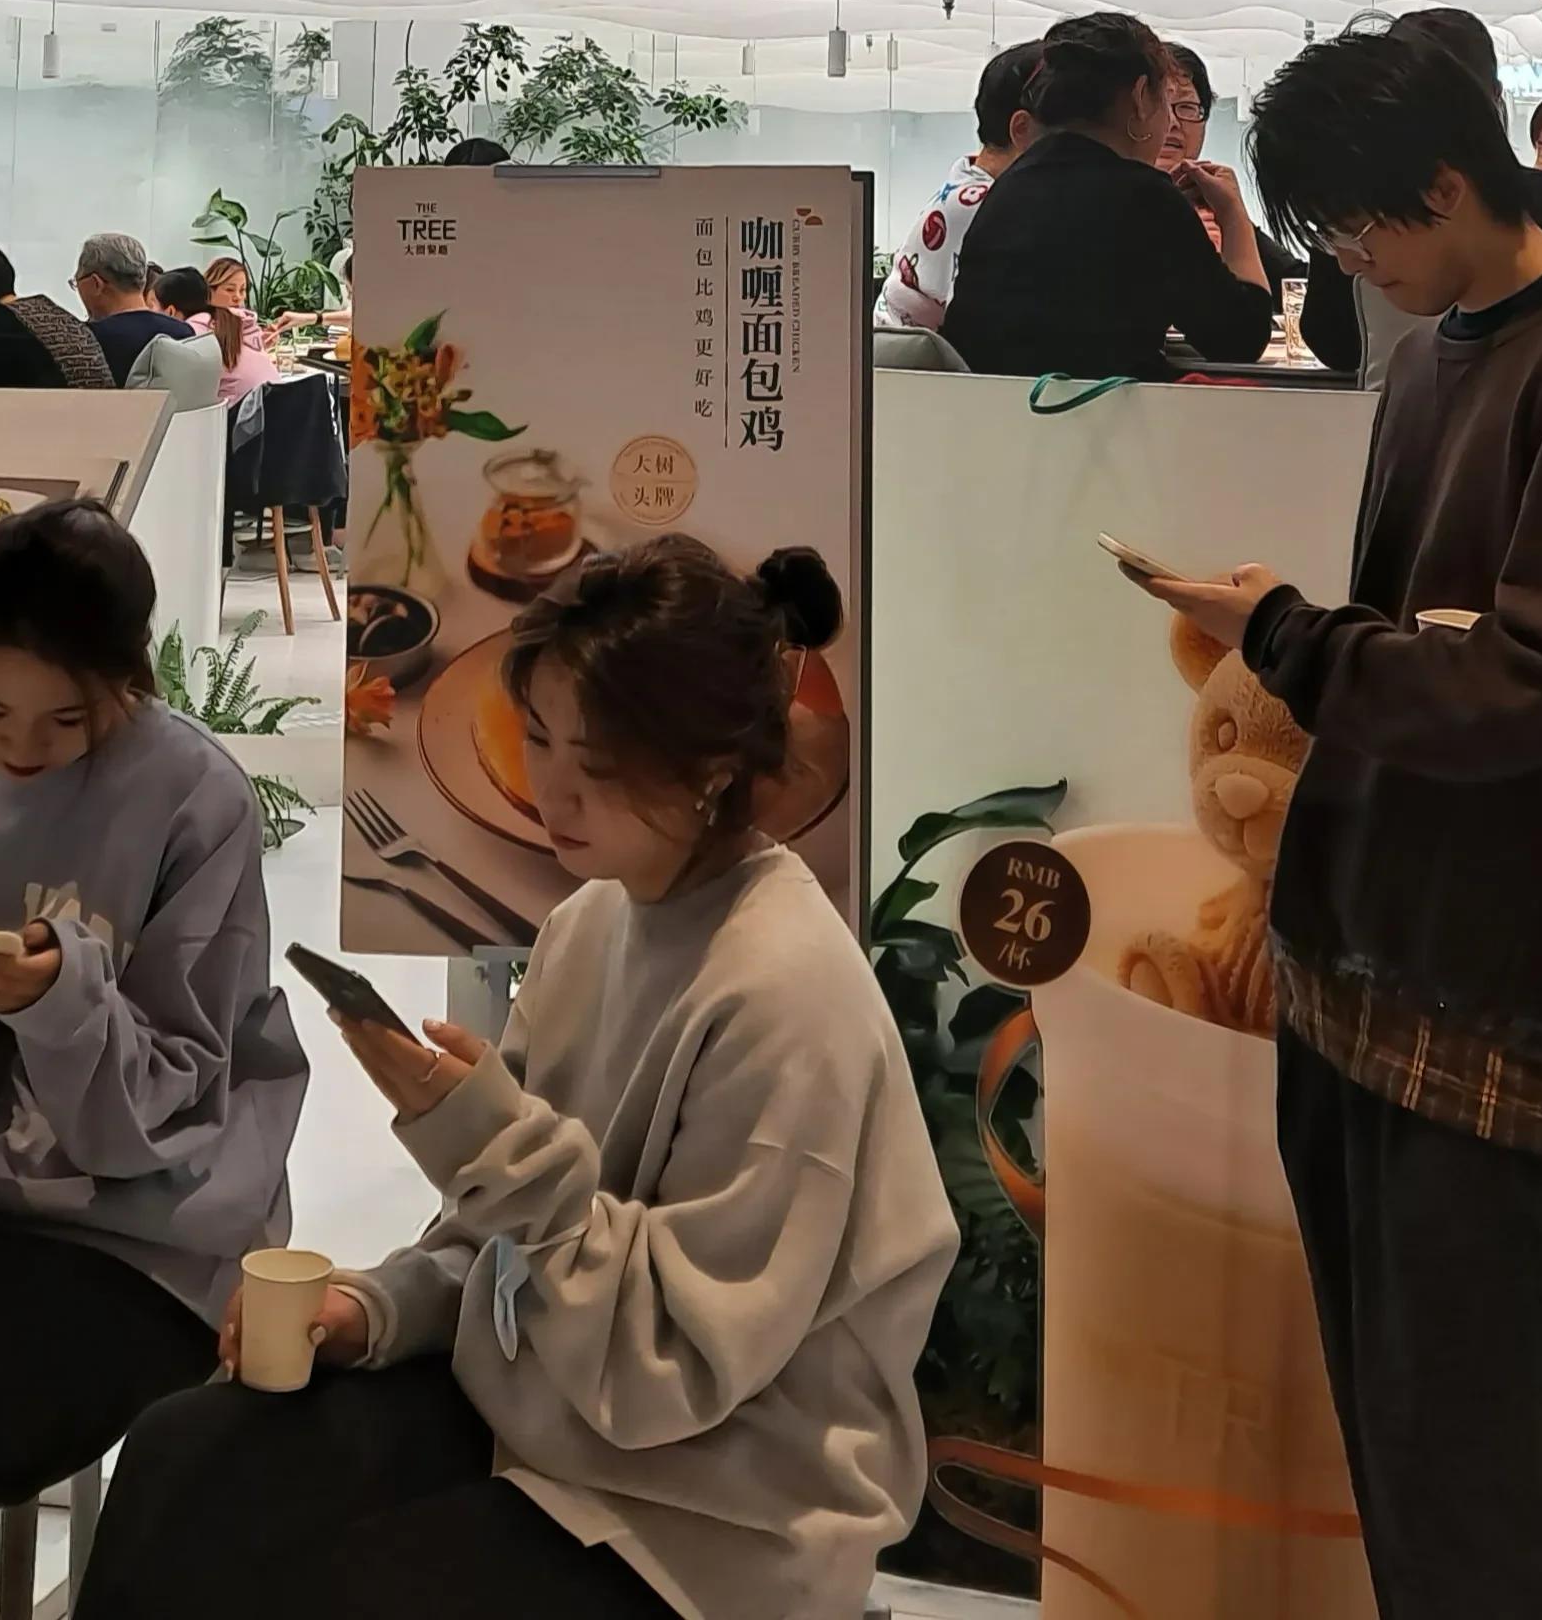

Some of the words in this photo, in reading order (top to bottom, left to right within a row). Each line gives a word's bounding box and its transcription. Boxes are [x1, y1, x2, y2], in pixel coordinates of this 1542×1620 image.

[415, 202, 438, 213] THE
[396, 219, 457, 241] TREE
[694, 217, 715, 419] 面包比鸡更好吃
[739, 216, 785, 452] 咖喱面包鸡
[632, 454, 674, 475] 大树
[634, 486, 675, 507] 头牌
[1006, 856, 1061, 891] RMB
[992, 888, 1057, 942] 26
